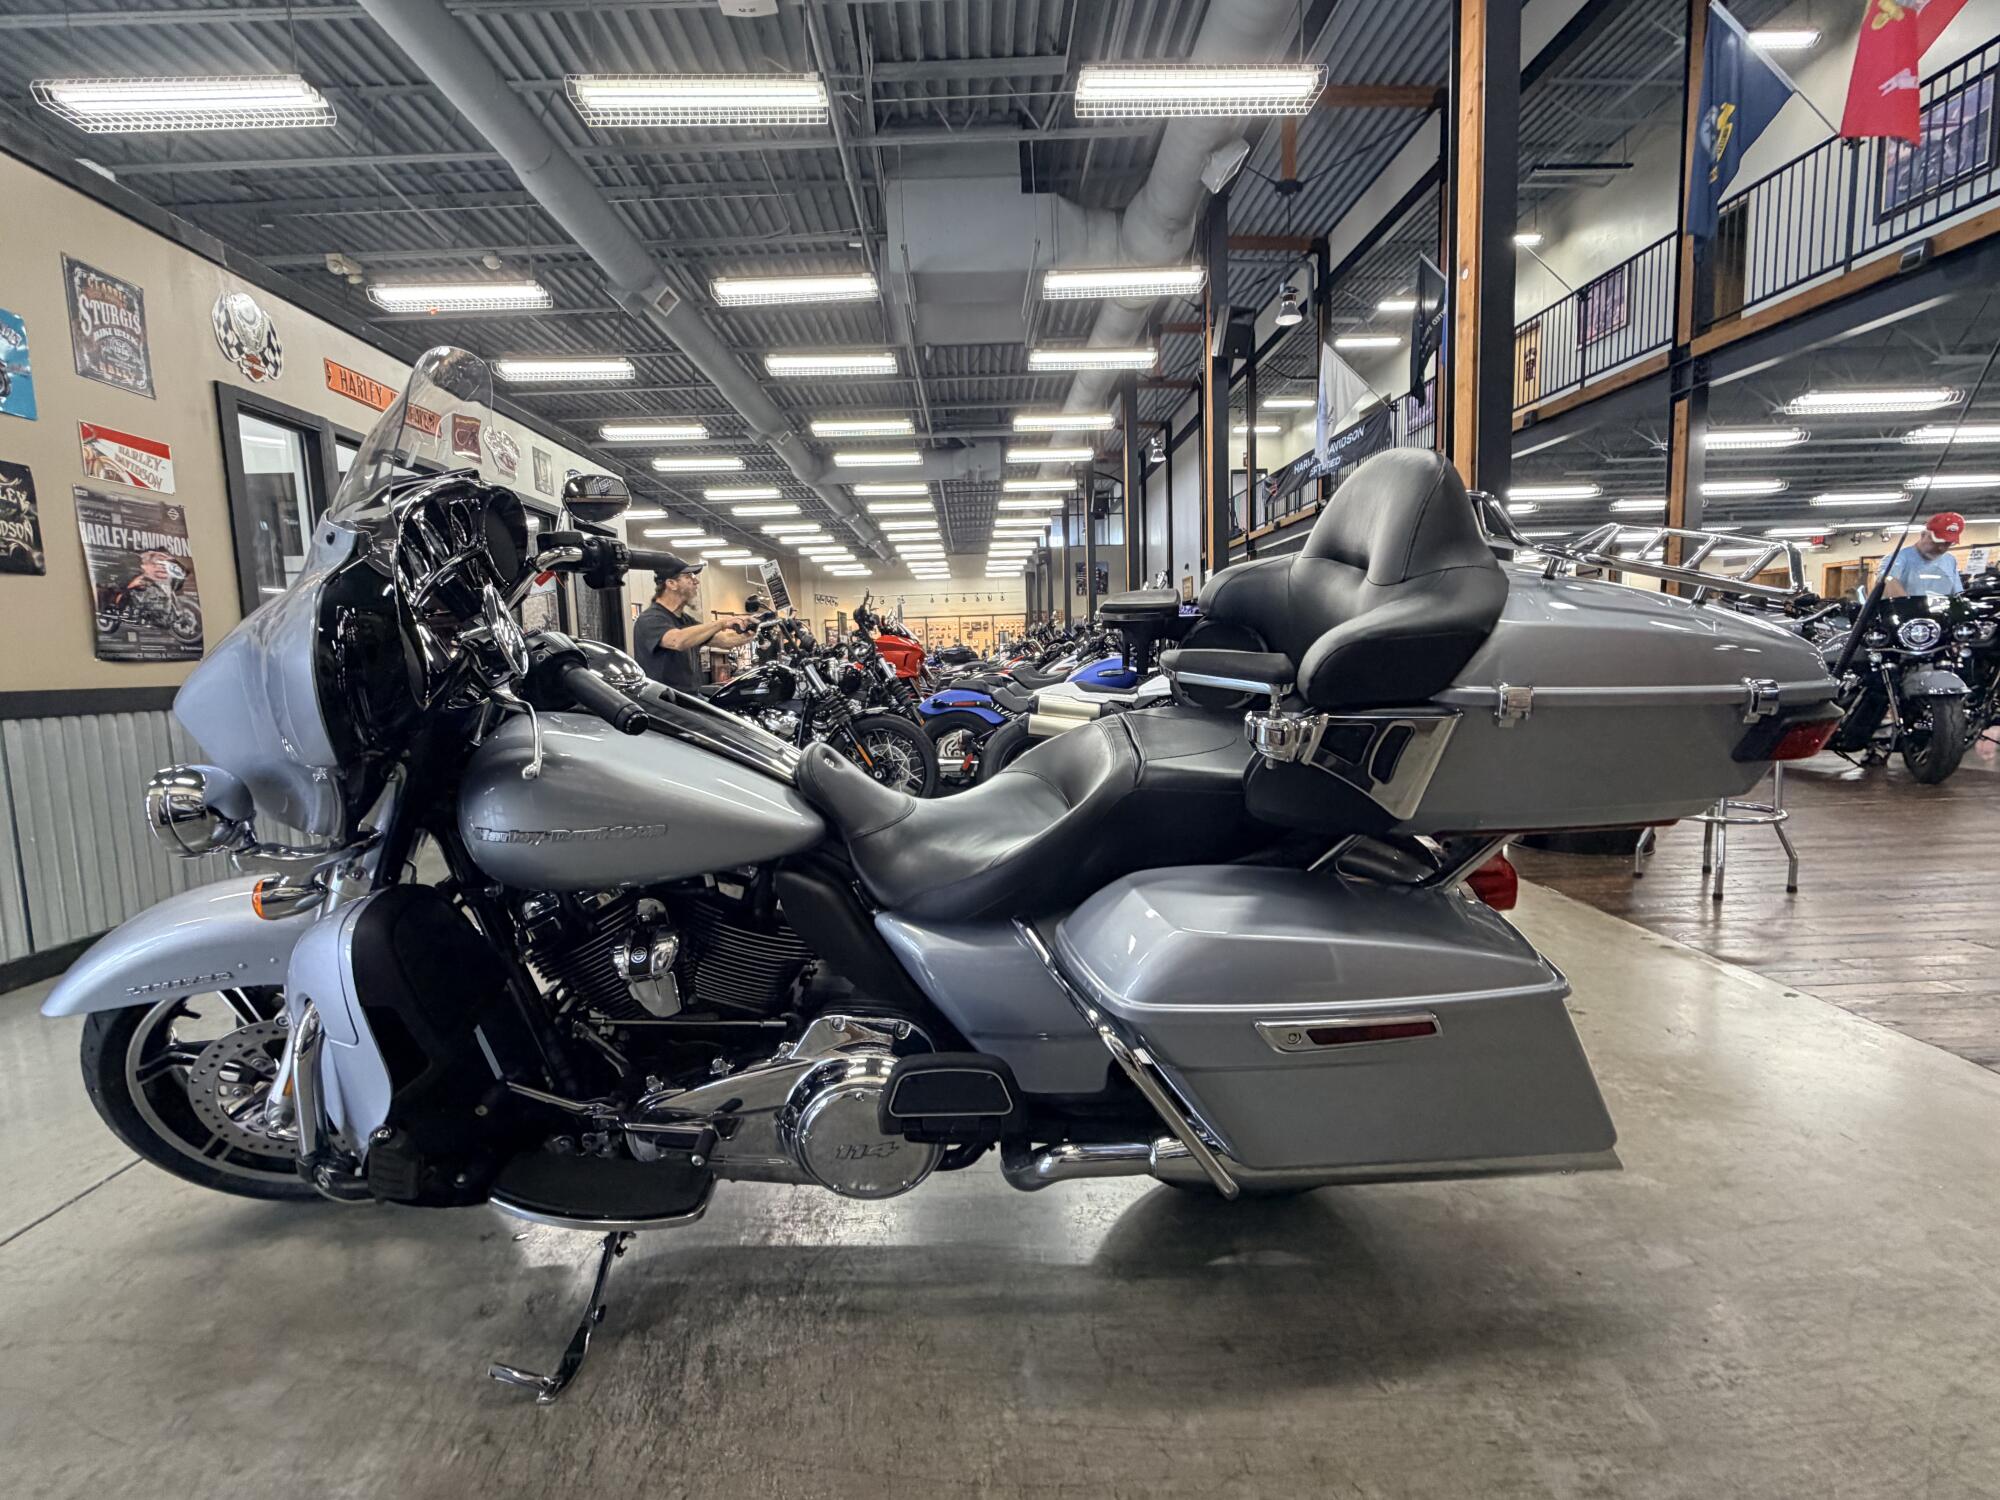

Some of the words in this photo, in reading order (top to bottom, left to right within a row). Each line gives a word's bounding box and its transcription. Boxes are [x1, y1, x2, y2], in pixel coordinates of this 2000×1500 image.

[79, 294, 142, 336] STURGIS
[339, 369, 383, 406] HARLEY
[114, 453, 164, 490] DAVIDSON
[118, 446, 167, 472] HARLEY-
[79, 520, 193, 558] HARLEY-DAVIDSON
